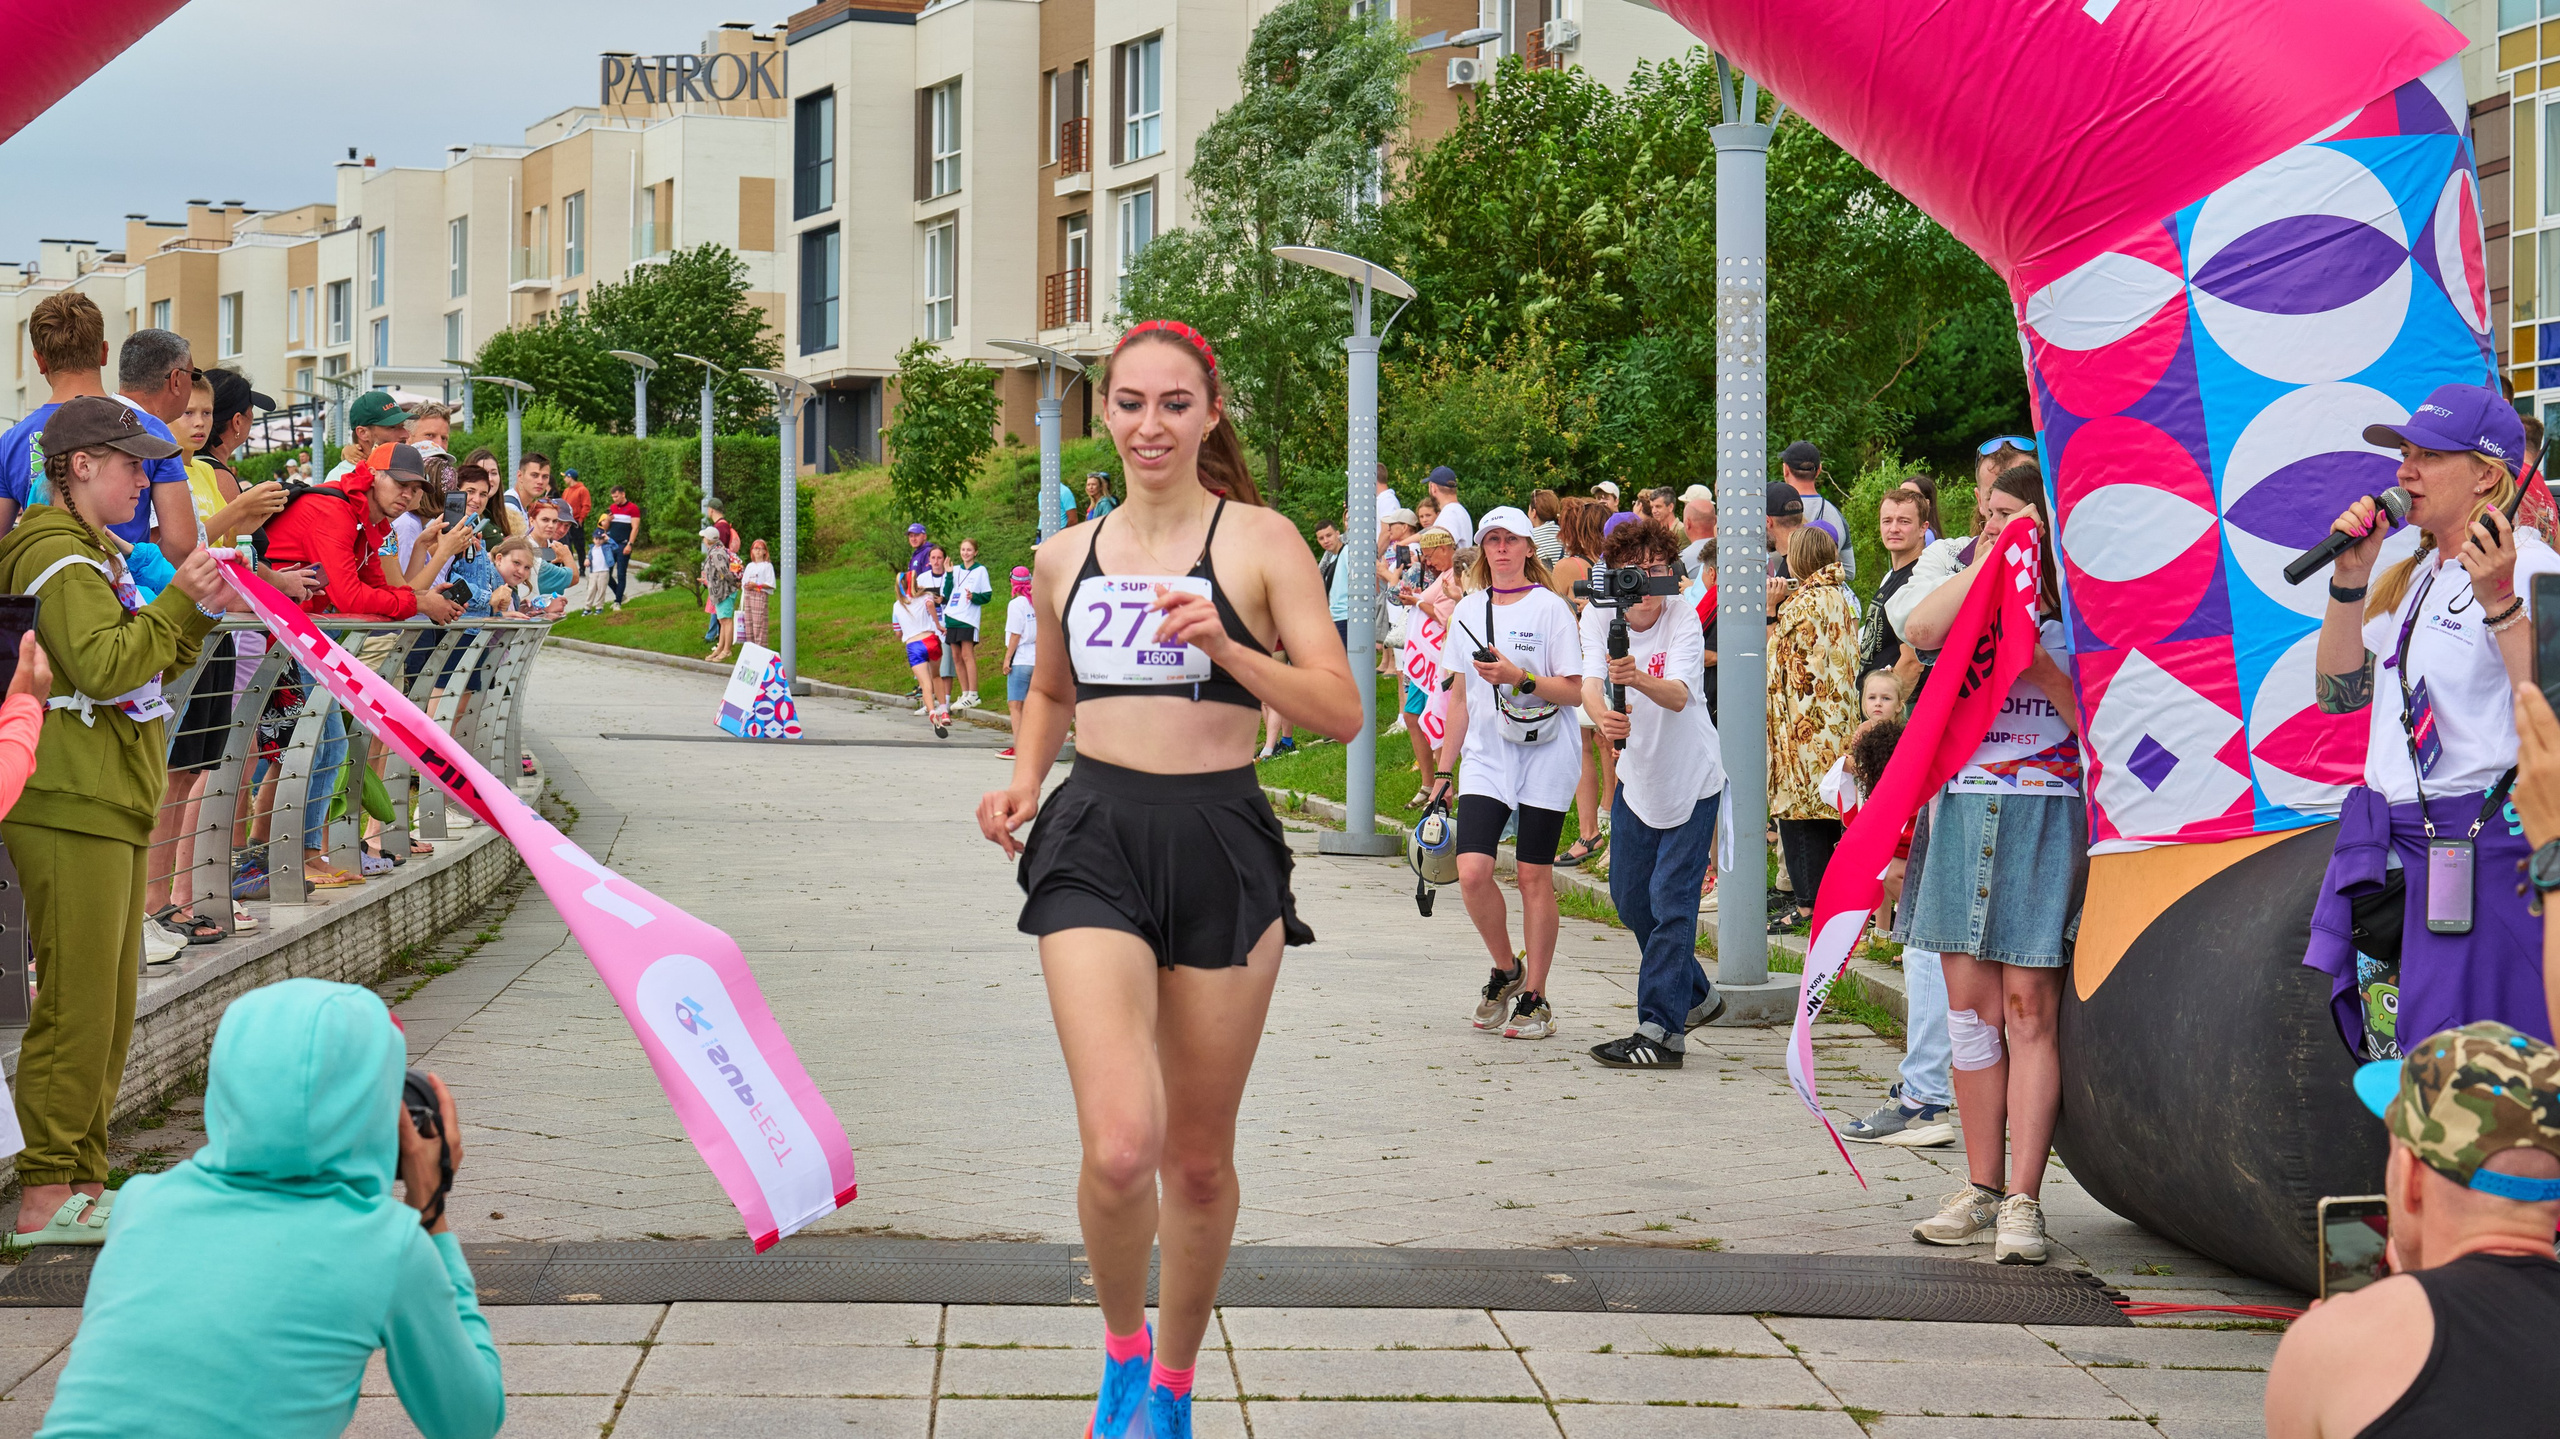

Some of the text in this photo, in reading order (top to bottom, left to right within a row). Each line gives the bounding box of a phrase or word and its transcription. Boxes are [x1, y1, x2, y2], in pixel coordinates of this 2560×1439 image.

[2478, 435, 2506, 458] Haier
[1514, 643, 1536, 652] Haier
[1143, 651, 1177, 665] 1600
[1999, 697, 2059, 717] ОНТЕ
[1981, 731, 2040, 745] SUPFEST
[1809, 972, 1826, 990] КЛУБ
